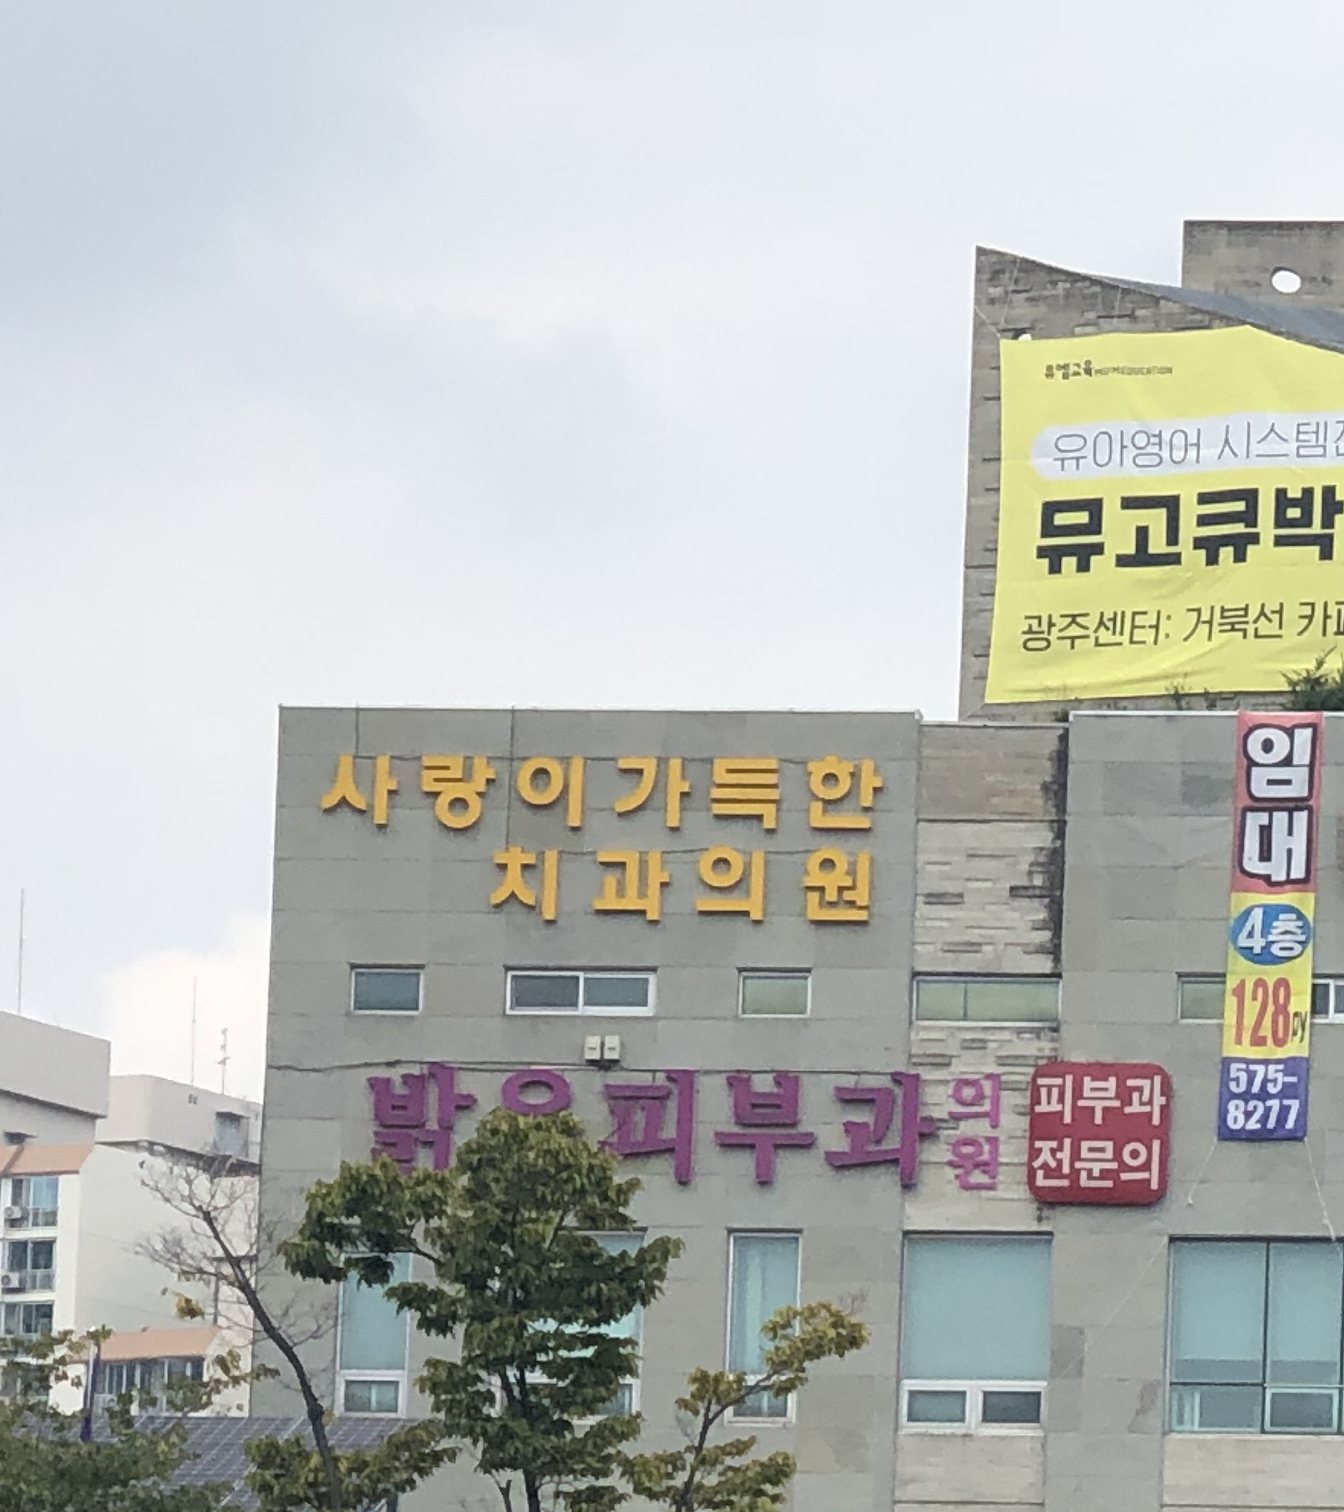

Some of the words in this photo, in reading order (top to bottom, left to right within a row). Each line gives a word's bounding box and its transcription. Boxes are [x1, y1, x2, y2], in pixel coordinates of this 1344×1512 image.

[1051, 427, 1203, 474] 유아영어
[1019, 606, 1175, 654] 광주센터:
[1182, 603, 1286, 646] 거북선
[320, 752, 884, 831] 사랑이가득한
[1241, 723, 1316, 886] 임대
[488, 844, 872, 924] 치과의원
[1236, 904, 1308, 959] 4층
[1032, 1074, 1168, 1119] 피부과
[1225, 1099, 1301, 1131] 8277
[1031, 1139, 1163, 1192] 전문의
